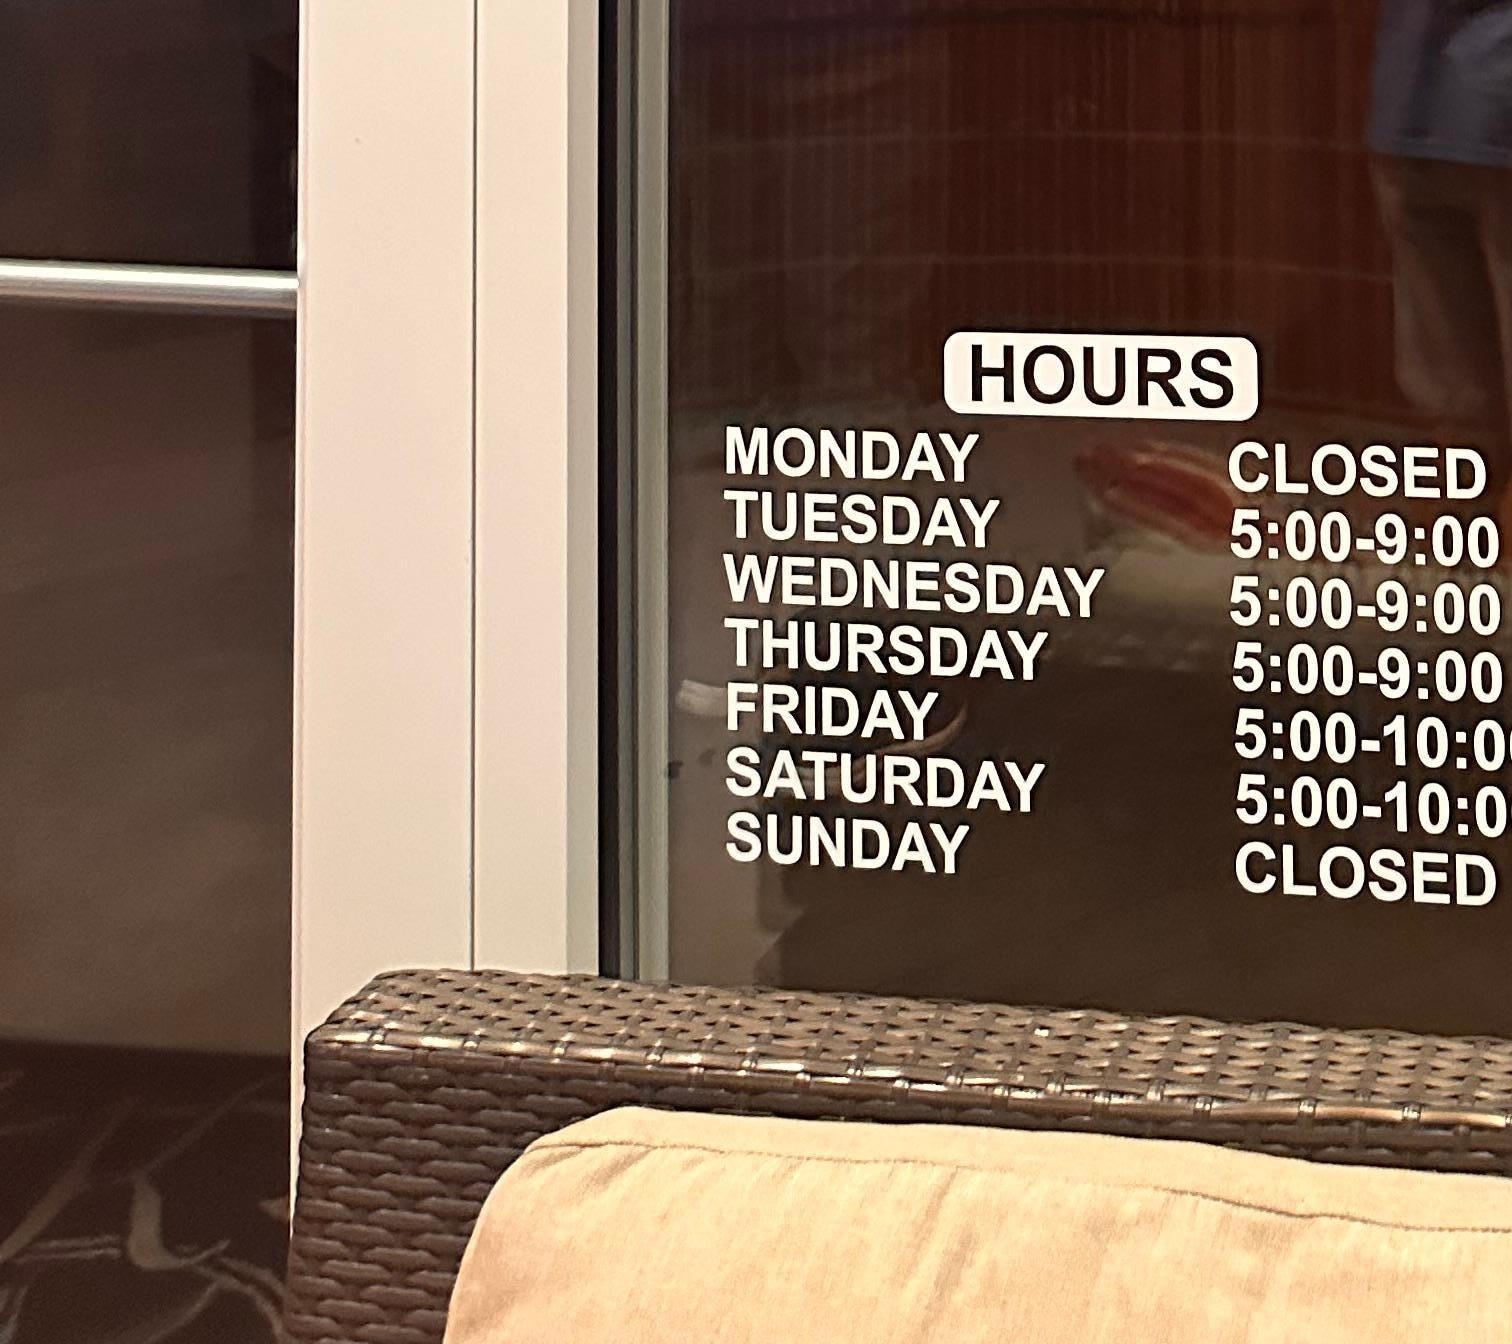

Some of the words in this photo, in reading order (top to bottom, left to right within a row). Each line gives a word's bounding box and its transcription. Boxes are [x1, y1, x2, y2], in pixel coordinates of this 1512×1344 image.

[972, 344, 1233, 408] HOURS
[724, 426, 979, 482] MONDAY
[1229, 442, 1486, 498] CLOSED
[724, 490, 999, 547] TUESDAY
[1231, 509, 1498, 567] 5:00-9:00
[723, 554, 1104, 617] WEDNESDAY
[1230, 576, 1500, 635] 5:00-9:00
[724, 618, 1048, 680] THURSDAY
[1233, 642, 1502, 703] 5:00-9:00
[726, 683, 938, 740] FRIDAY
[726, 747, 1045, 812] SATURDAY
[727, 812, 969, 873] SUNDAY
[1236, 842, 1496, 905] CLOSED
